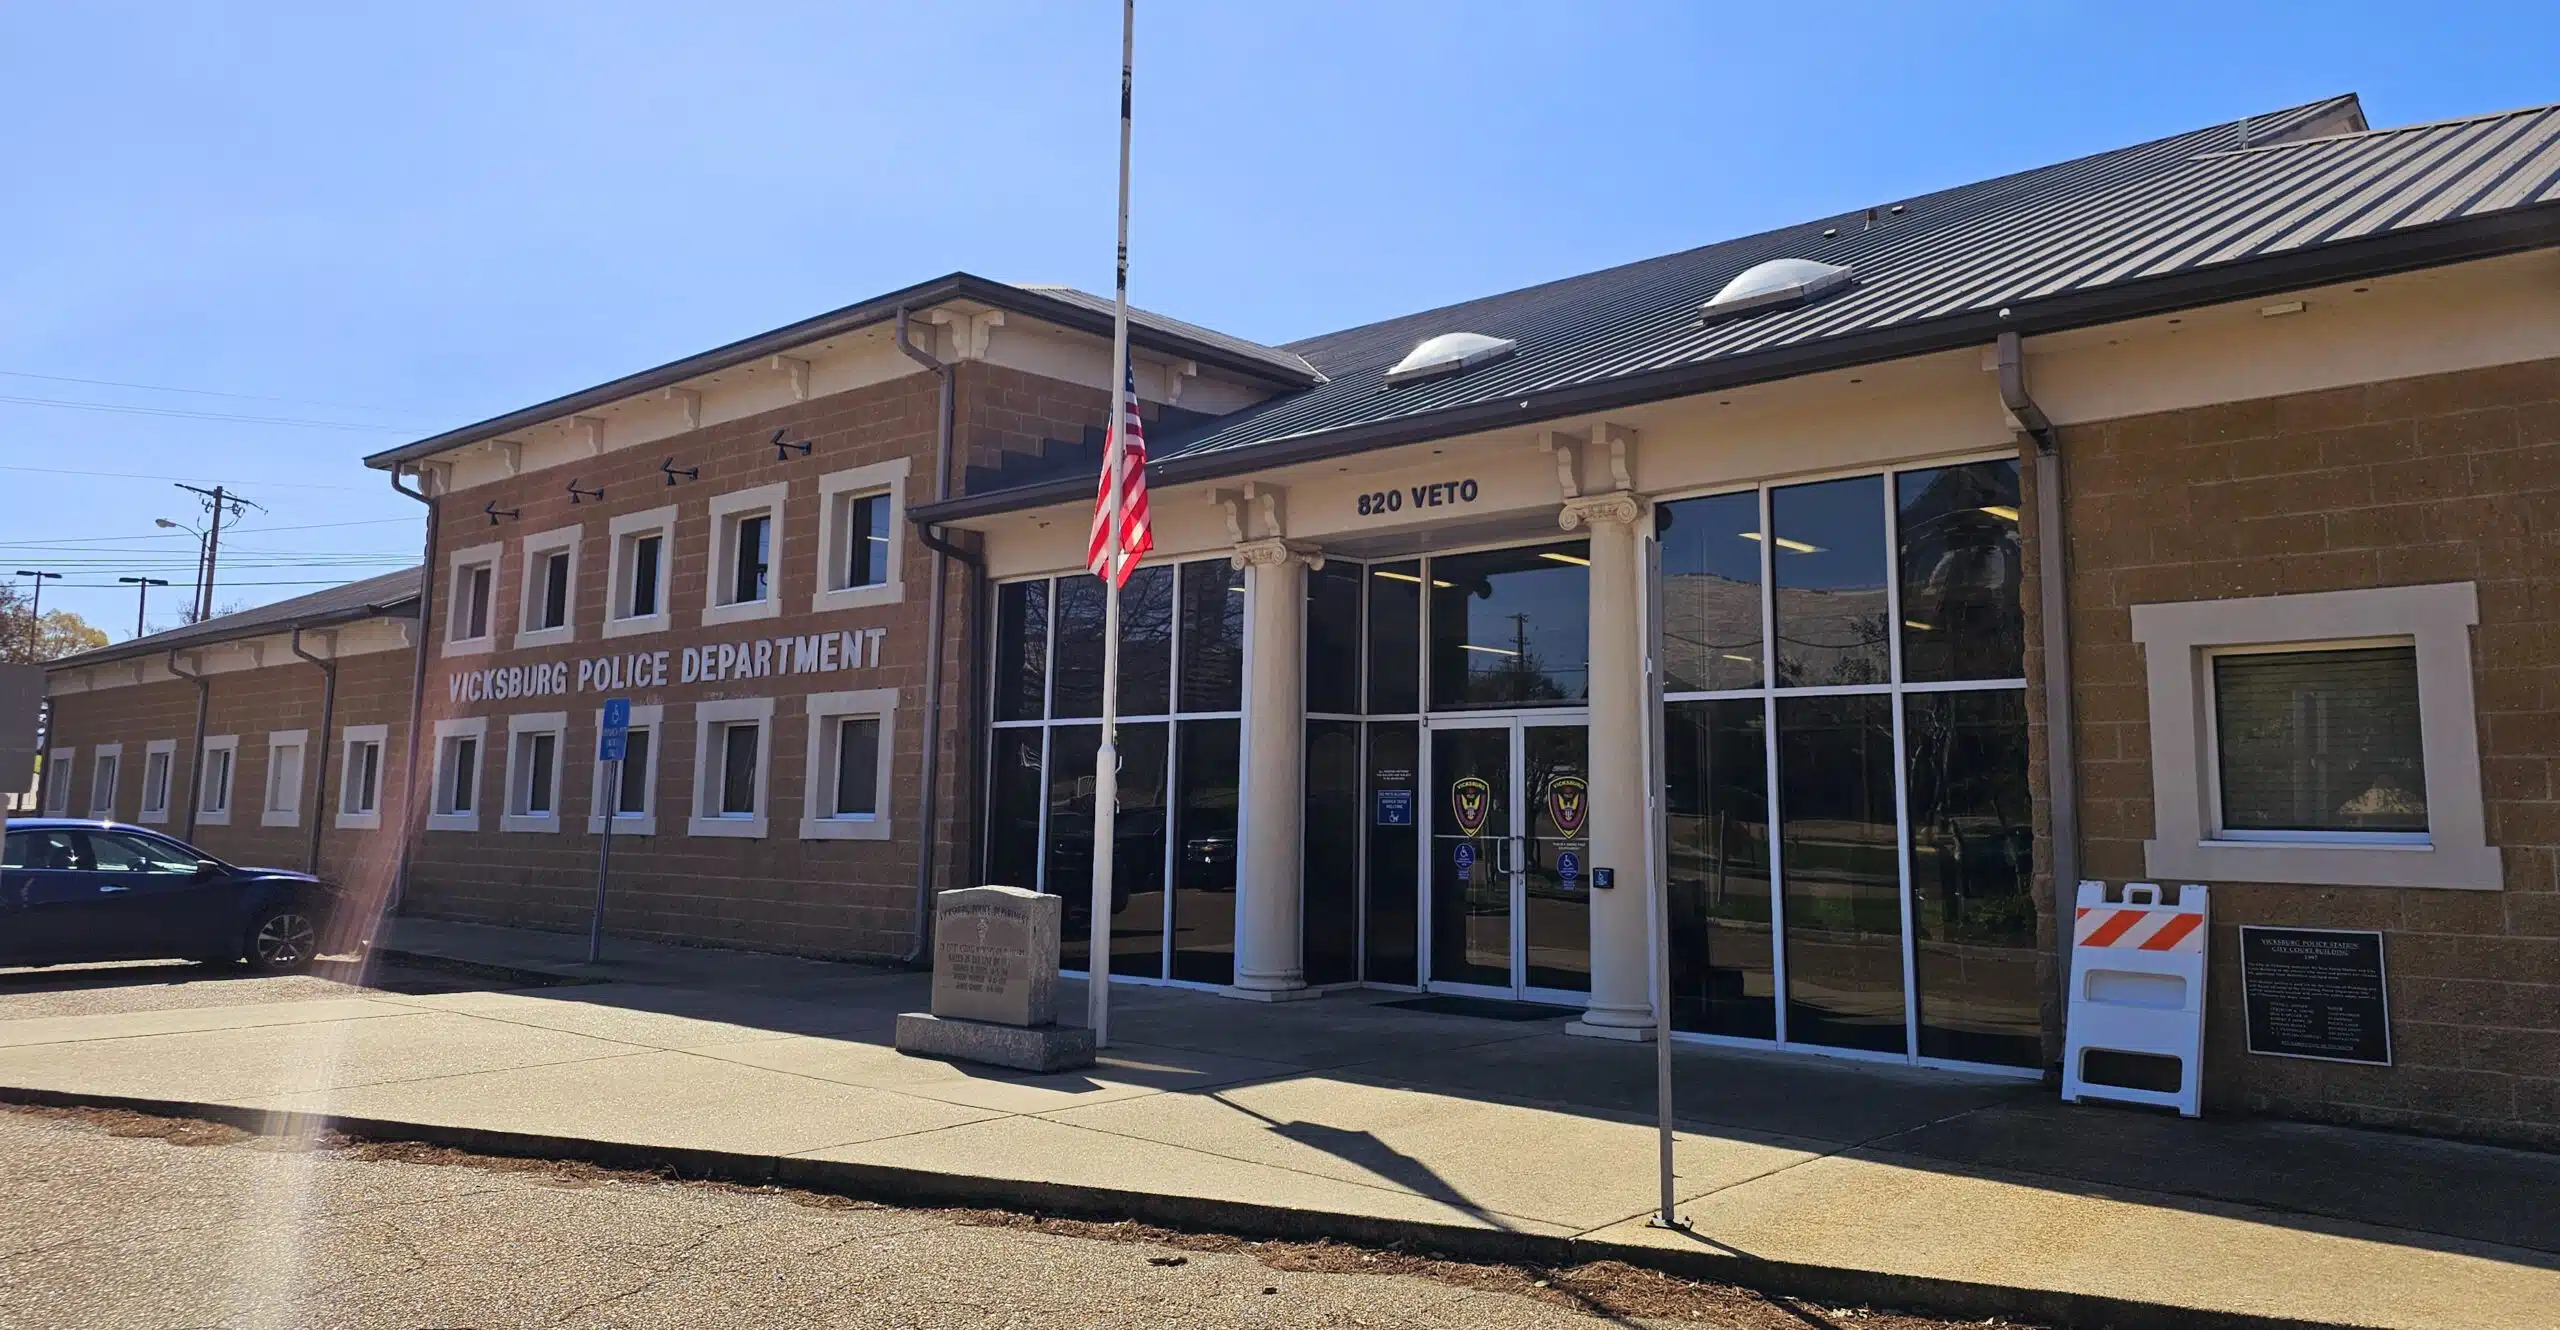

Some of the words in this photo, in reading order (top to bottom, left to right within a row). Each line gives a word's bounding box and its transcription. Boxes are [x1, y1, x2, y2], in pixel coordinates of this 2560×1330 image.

[1357, 489, 1402, 516] 820
[1411, 479, 1478, 508] VETO
[449, 661, 568, 702] VICKSBURG
[577, 650, 670, 692] POLICE
[680, 627, 888, 684] DEPARTMENT
[2261, 938, 2300, 947] VICKSBURG
[2302, 940, 2327, 948] POLICE
